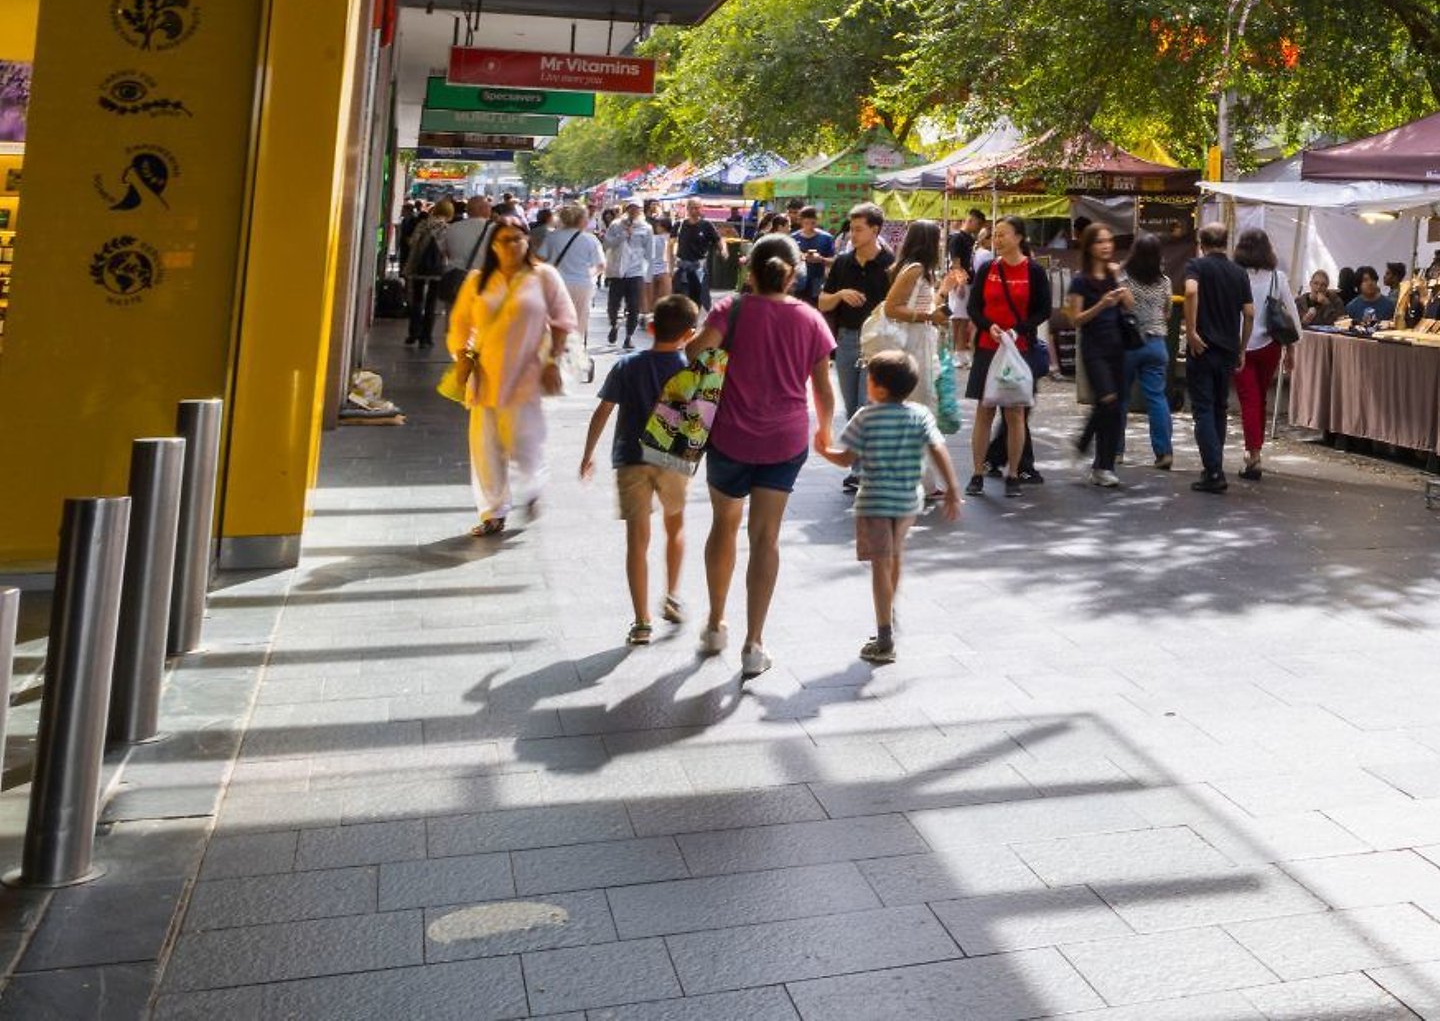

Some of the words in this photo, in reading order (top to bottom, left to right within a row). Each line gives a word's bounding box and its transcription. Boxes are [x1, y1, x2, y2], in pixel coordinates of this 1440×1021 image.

[540, 56, 563, 72] Mr
[566, 58, 640, 76] Vitamins
[484, 90, 542, 103] Specsavers
